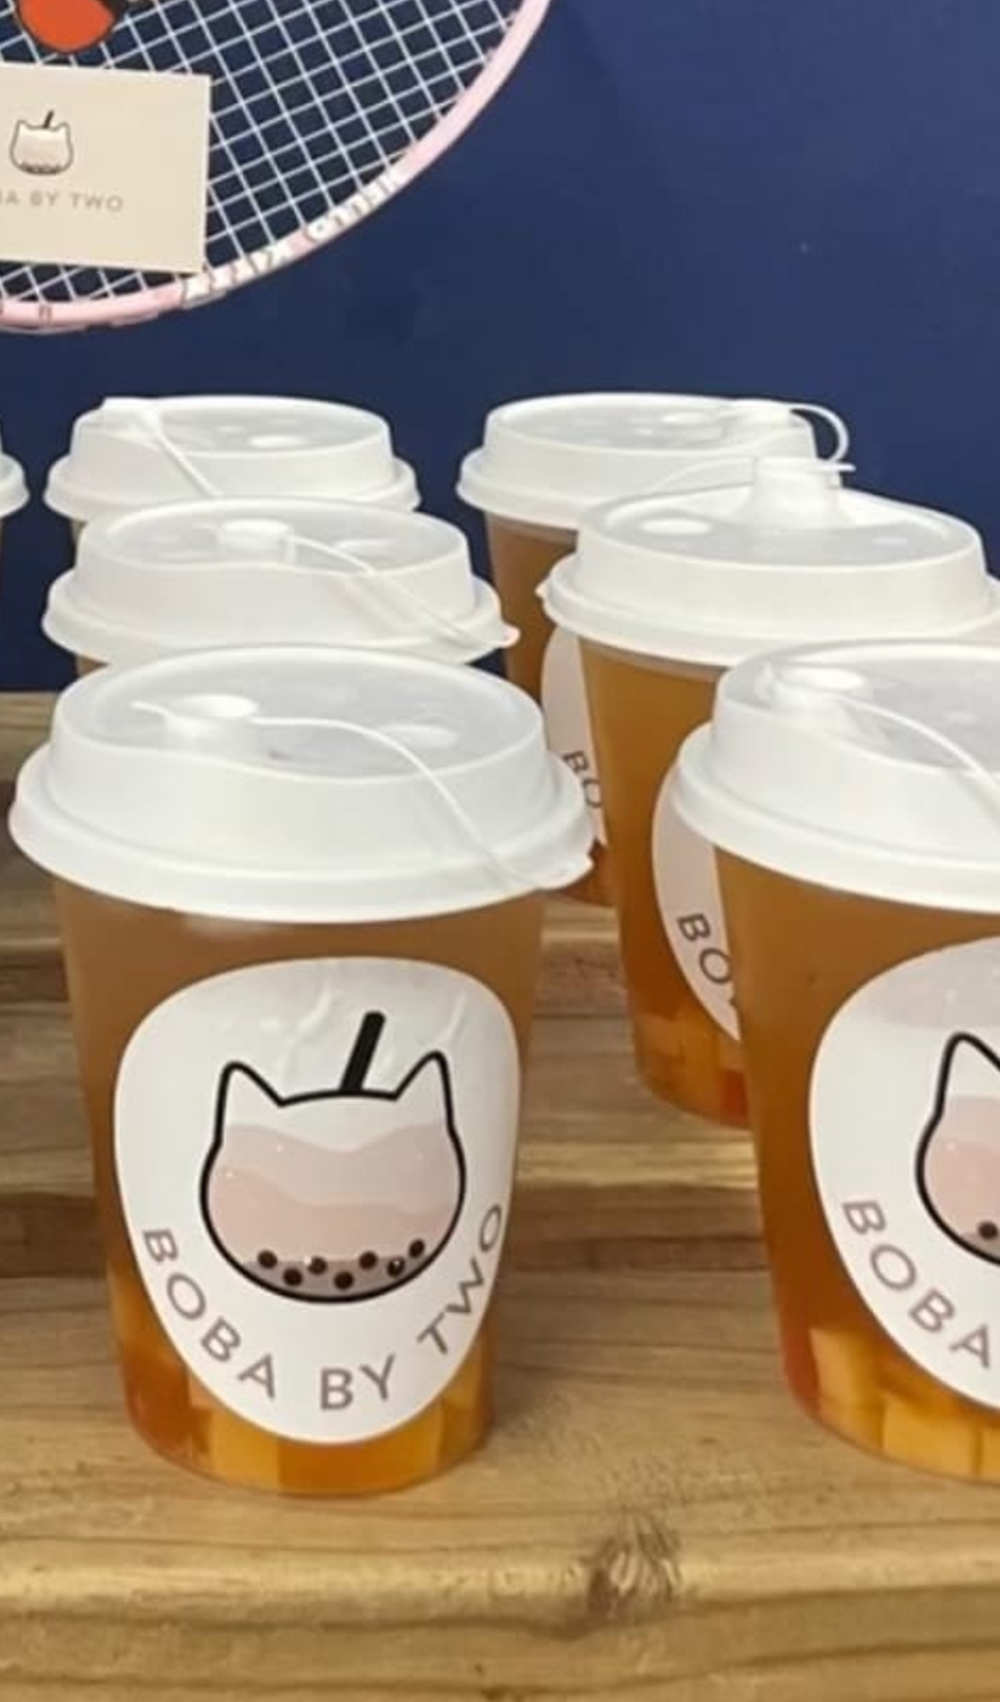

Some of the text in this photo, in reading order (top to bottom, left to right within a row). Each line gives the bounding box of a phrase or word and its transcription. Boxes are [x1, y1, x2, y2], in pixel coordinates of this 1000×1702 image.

[29, 190, 59, 207] BY
[70, 192, 124, 212] TWO
[677, 913, 733, 984] BO
[142, 1204, 502, 1411] BOBA BY TWO
[841, 1201, 990, 1370] BOBA
